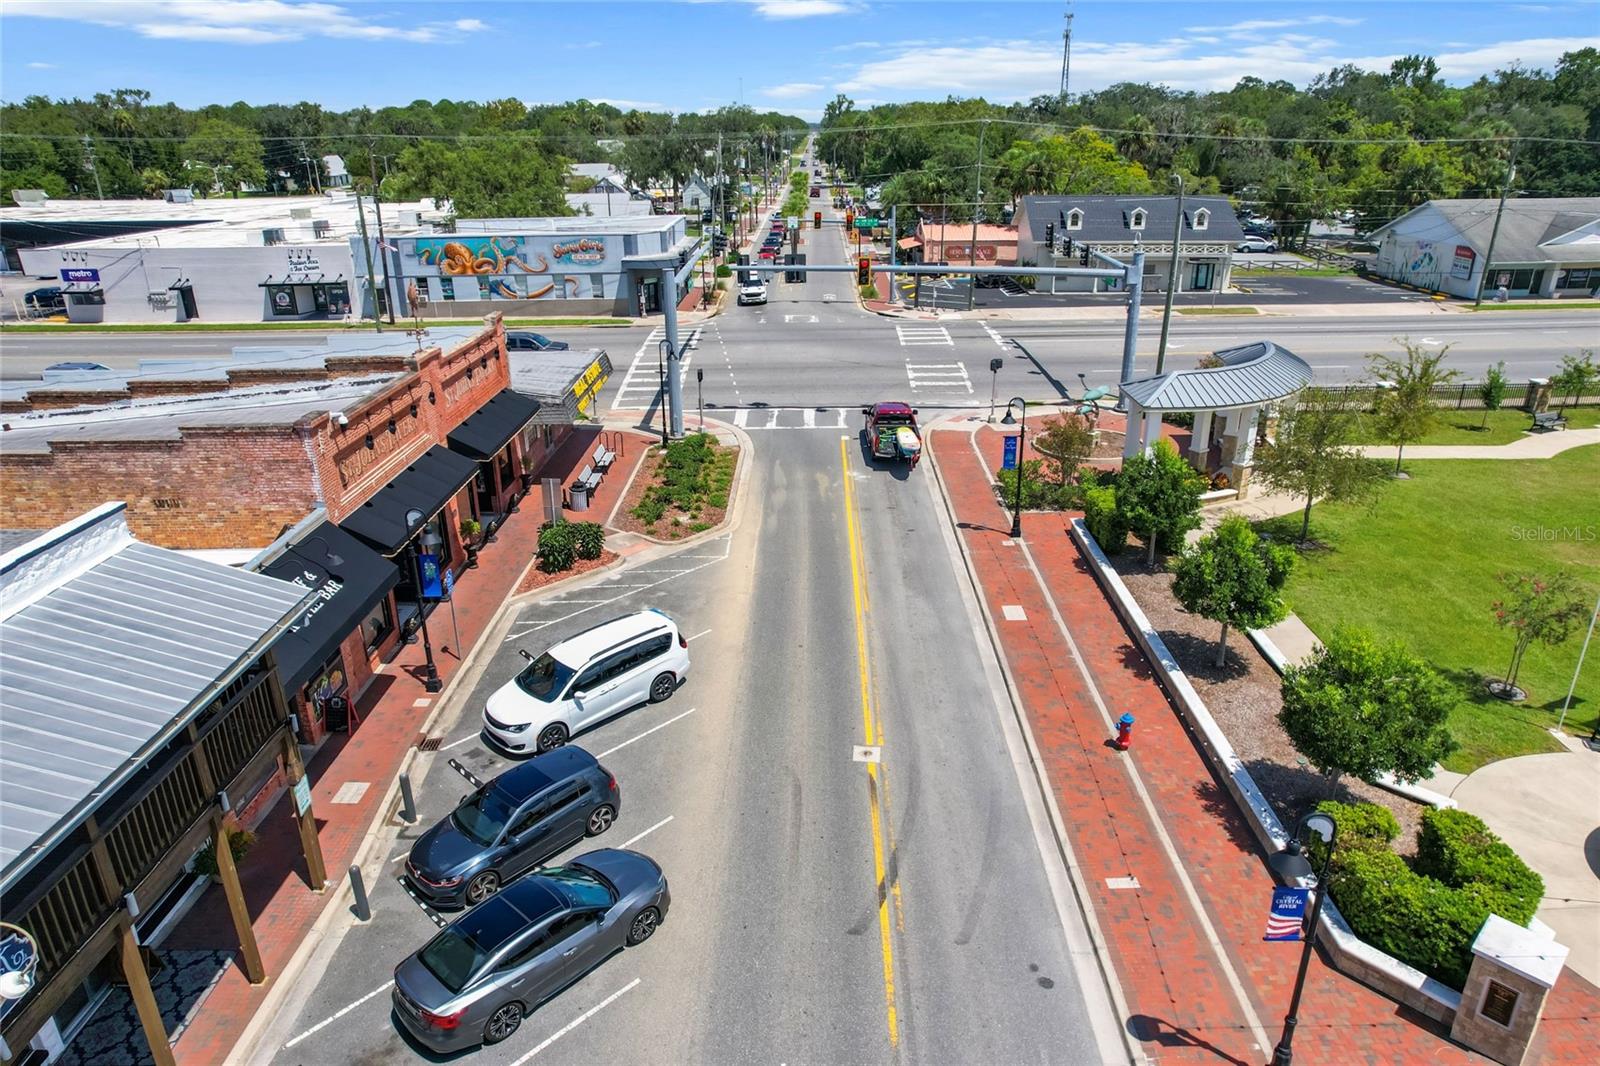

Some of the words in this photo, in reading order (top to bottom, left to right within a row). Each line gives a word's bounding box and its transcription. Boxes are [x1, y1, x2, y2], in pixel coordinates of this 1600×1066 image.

[69, 270, 92, 278] metro
[304, 570, 317, 581] &
[317, 579, 343, 600] BAR
